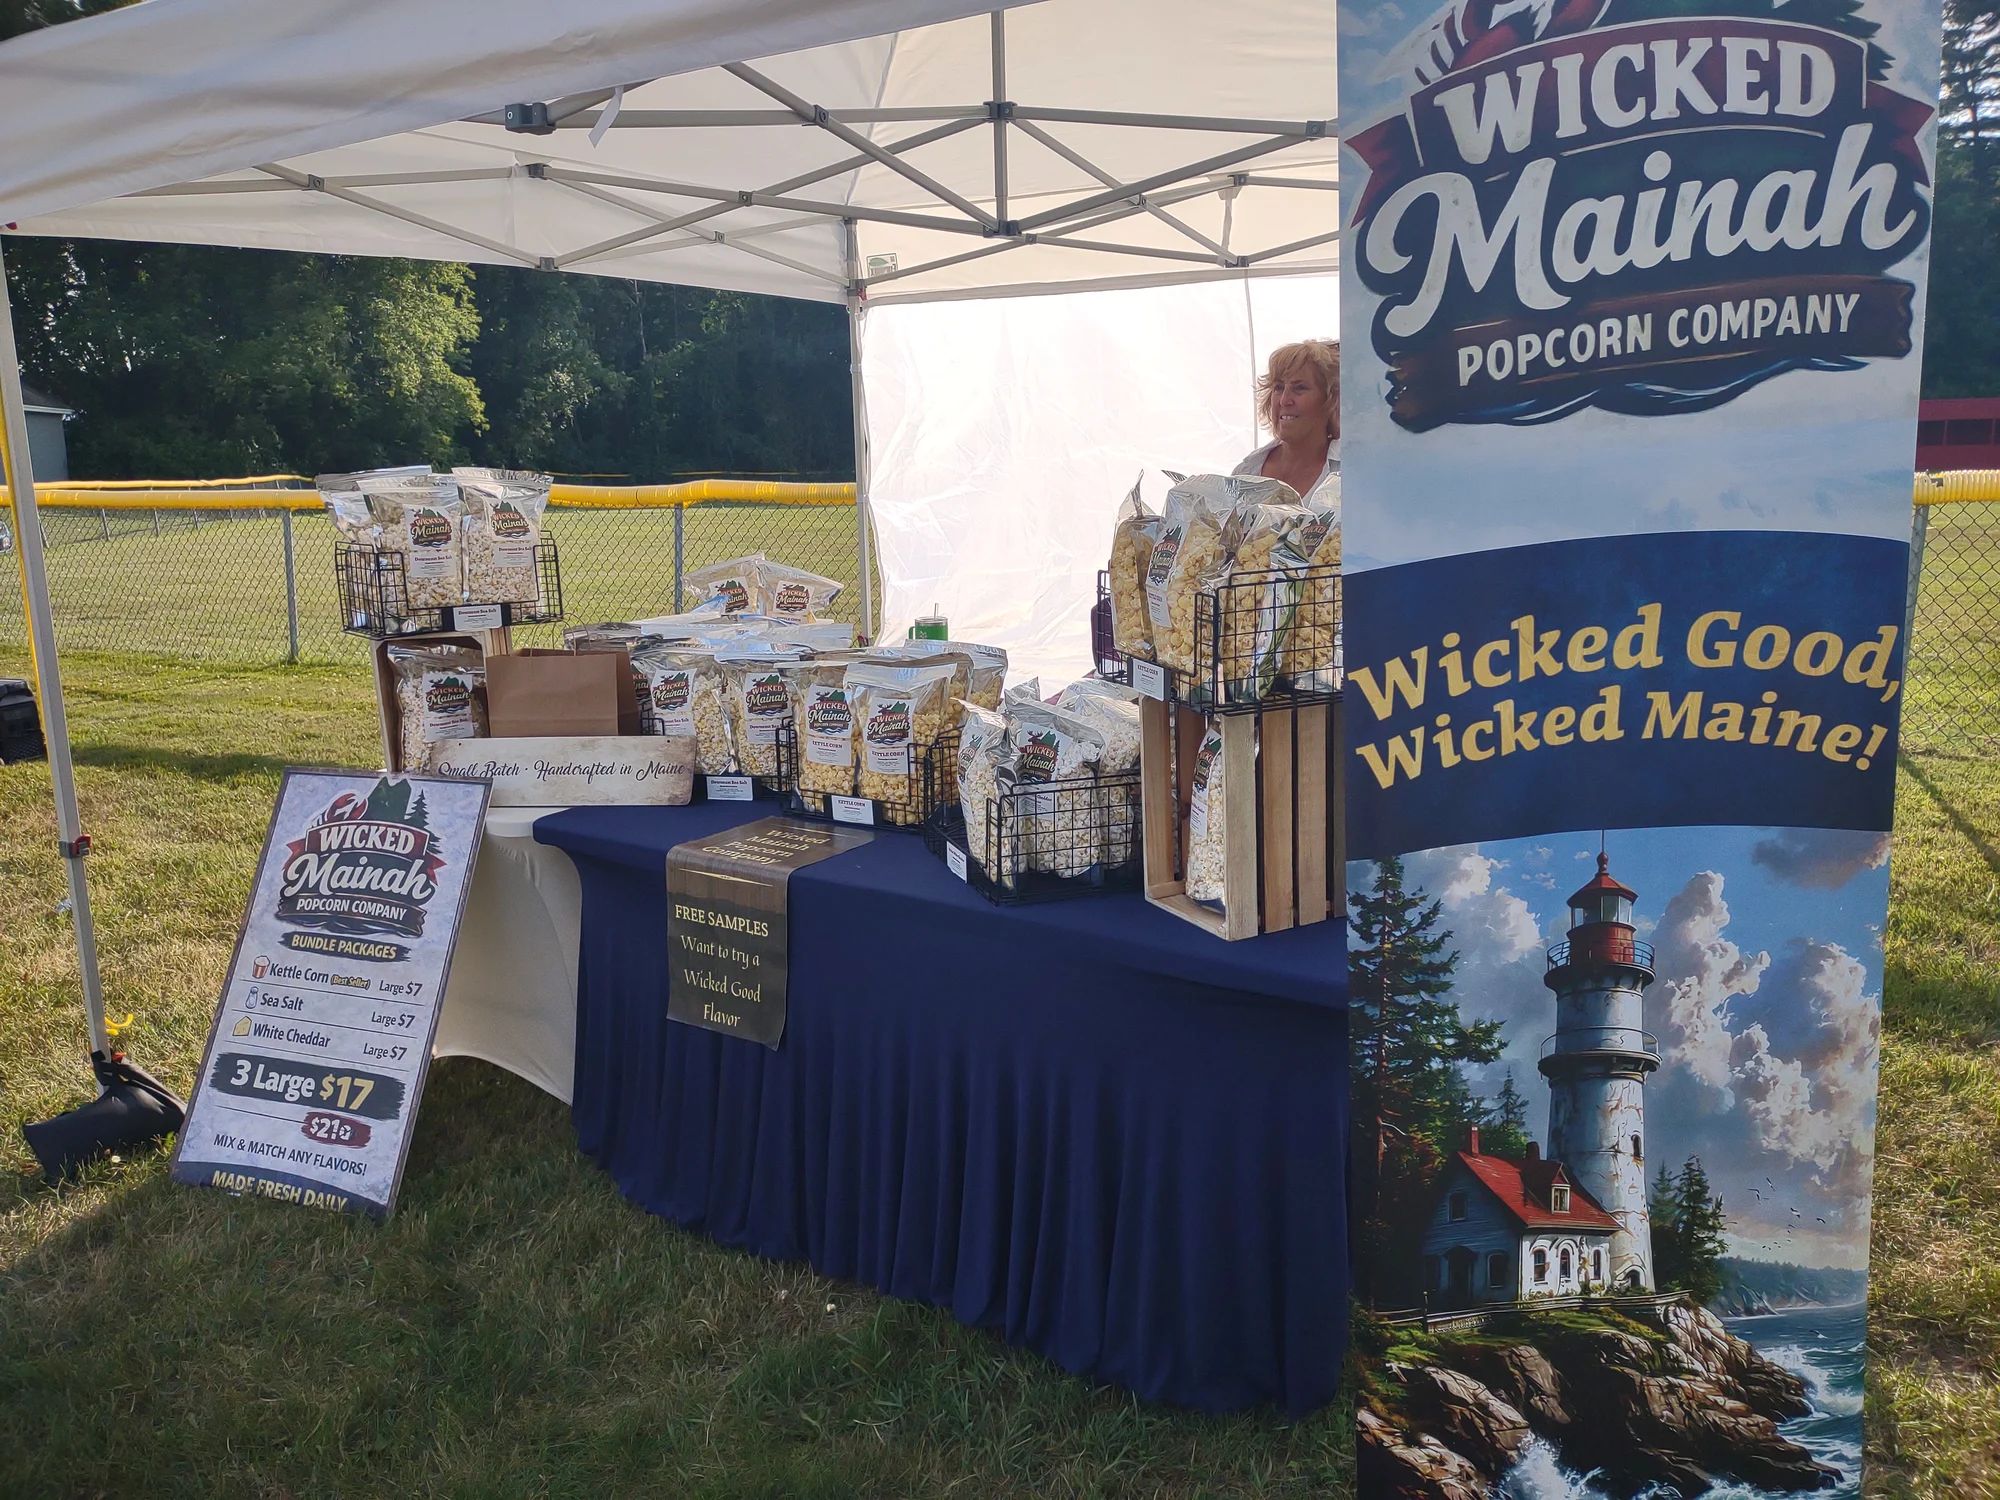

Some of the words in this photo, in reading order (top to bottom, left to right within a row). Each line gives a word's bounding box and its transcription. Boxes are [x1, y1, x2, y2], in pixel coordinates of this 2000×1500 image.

[1434, 36, 1837, 165] WICKED
[1366, 124, 1916, 337] Mainah
[1458, 312, 1653, 386] POPCORN
[1668, 294, 1860, 349] COMPANY
[412, 524, 452, 539] Mainah
[1348, 603, 1663, 721] Wicked
[1686, 610, 1900, 703] Good,
[652, 688, 689, 701] Mainah
[746, 693, 788, 707] Mainah
[752, 686, 783, 694] WICKED
[808, 709, 851, 723] Mainah
[814, 702, 848, 710] WICKED
[876, 714, 905, 723] WICKED
[868, 721, 910, 735] Mainah
[1355, 684, 1624, 790] Wicked
[1641, 690, 1888, 771] Maine!
[1026, 745, 1054, 758] WICKED
[438, 762, 478, 777] Small
[480, 761, 520, 778] Batch
[534, 760, 616, 784] Handcrafted
[619, 764, 633, 776] in
[636, 761, 686, 782] Maine
[318, 825, 415, 855] WICKED
[724, 841, 794, 858] Popcorn
[746, 836, 809, 851] Mainah
[766, 830, 831, 844] Wicked
[702, 846, 782, 865] Company
[284, 853, 432, 900] Mainah
[296, 898, 348, 913] POPCORN
[352, 900, 408, 920] COMPANY
[675, 904, 705, 924] FREE
[708, 911, 769, 937] SAMPLES
[292, 934, 335, 952] BUNDLE
[337, 940, 397, 959] PACKAGES
[680, 935, 715, 955] Want
[718, 943, 728, 959] to
[732, 945, 750, 970] try
[752, 954, 760, 966] a
[270, 963, 302, 980] Kettle
[304, 968, 329, 984] Corn
[379, 980, 404, 996] Large
[405, 981, 423, 996] $7
[684, 968, 728, 994] Wicked
[730, 980, 761, 1003] Good
[260, 993, 279, 1007] Sea
[281, 996, 304, 1011] Salt
[371, 1012, 396, 1027] Large
[397, 1013, 416, 1029] $7
[703, 1004, 741, 1027] Flavor
[253, 1022, 284, 1039] White
[286, 1028, 331, 1048] Cheddar
[363, 1043, 389, 1059] Large
[389, 1046, 408, 1061] $7
[230, 1059, 252, 1086] 3
[253, 1064, 316, 1102] Large
[320, 1073, 376, 1111] $17
[214, 1134, 236, 1149] MIX
[237, 1139, 246, 1151] &
[248, 1141, 287, 1159] MATCH
[287, 1149, 312, 1164] ANY
[313, 1154, 368, 1176] FLAVORS!
[212, 1170, 256, 1192] MADE
[256, 1178, 301, 1204] FRESH
[303, 1188, 348, 1212] DAILY
